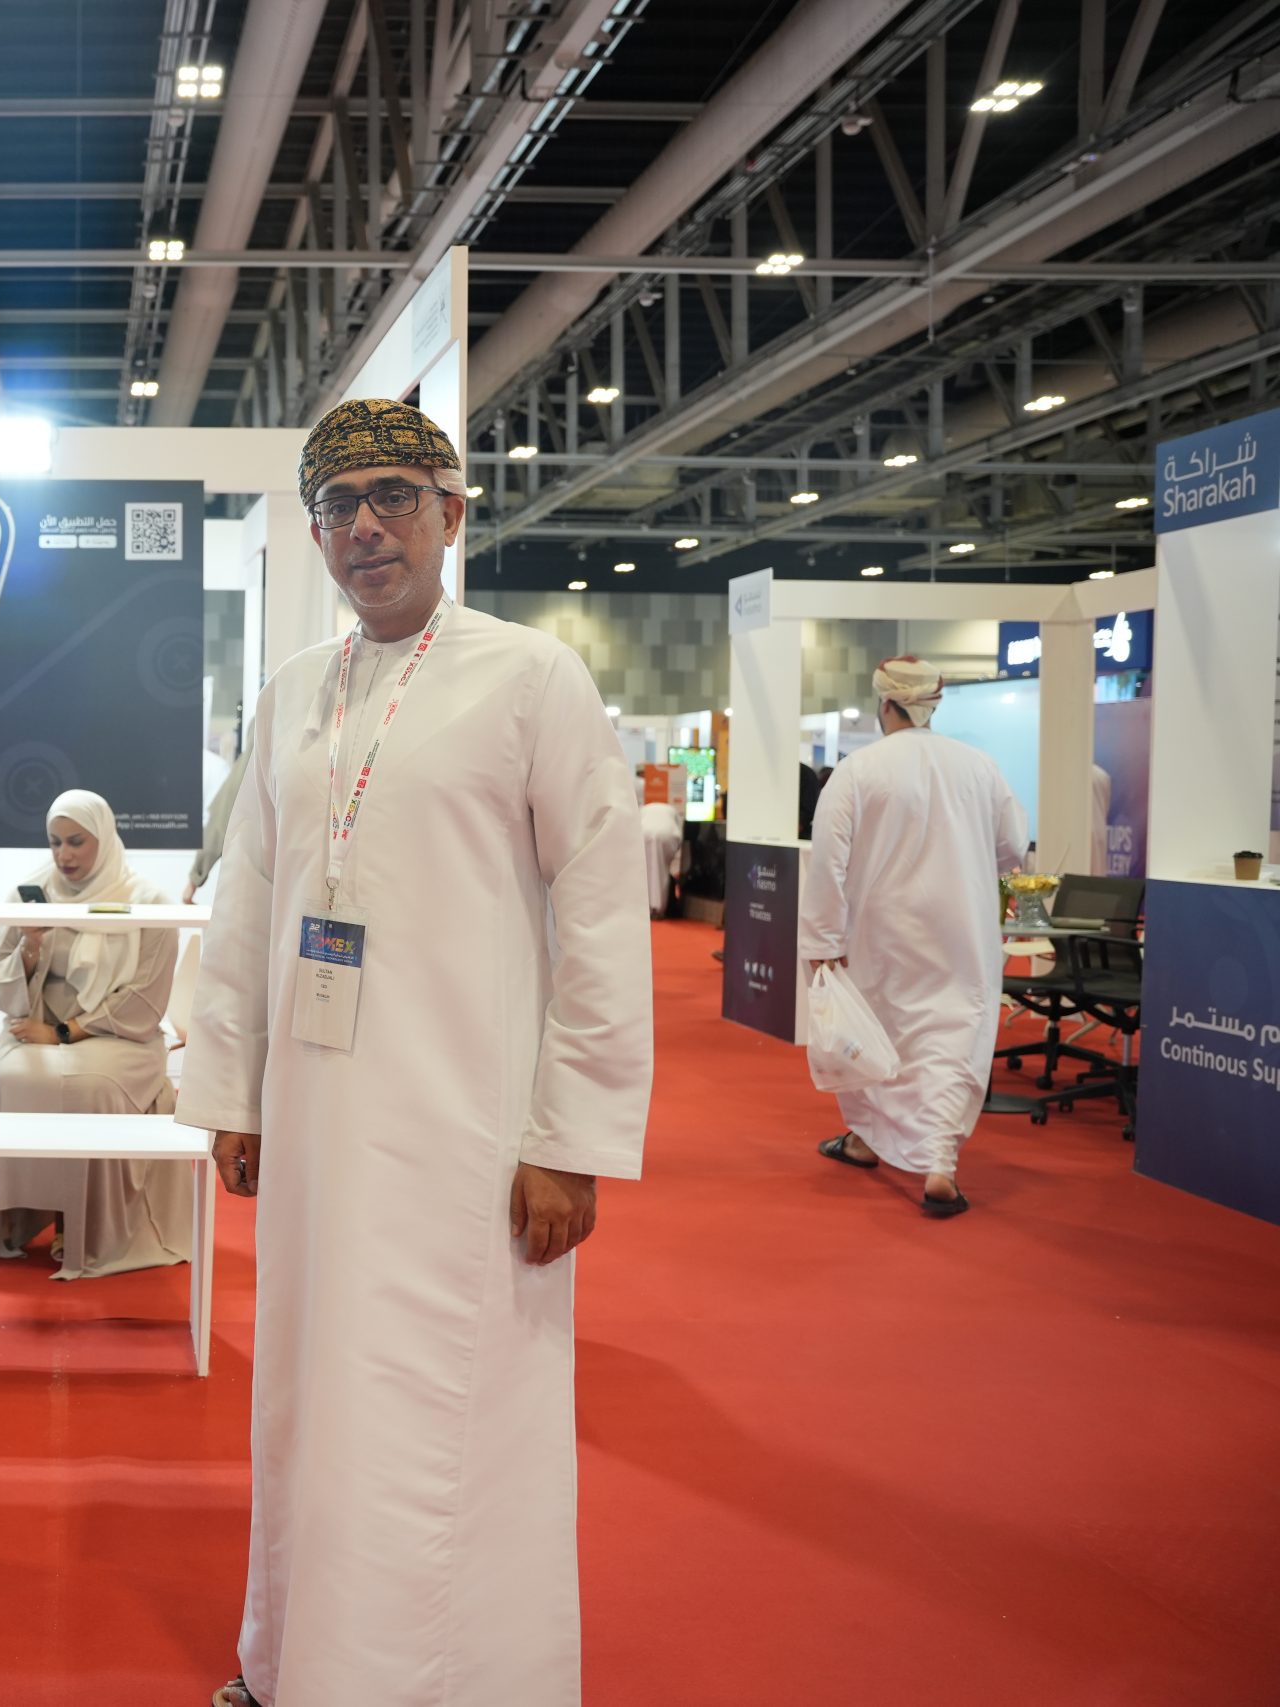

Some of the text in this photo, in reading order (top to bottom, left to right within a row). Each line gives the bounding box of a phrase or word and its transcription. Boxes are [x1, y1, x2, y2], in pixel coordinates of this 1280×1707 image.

[1164, 432, 1257, 482] شراكة
[1162, 466, 1256, 518] Sharakah
[58, 516, 95, 529] التطبيق
[96, 517, 118, 529] حمل
[397, 661, 415, 686] COMEX
[343, 799, 356, 826] COMEX
[308, 922, 320, 931] 32
[1169, 1005, 1257, 1042] مستمر
[1160, 1037, 1280, 1092] Continous Su
